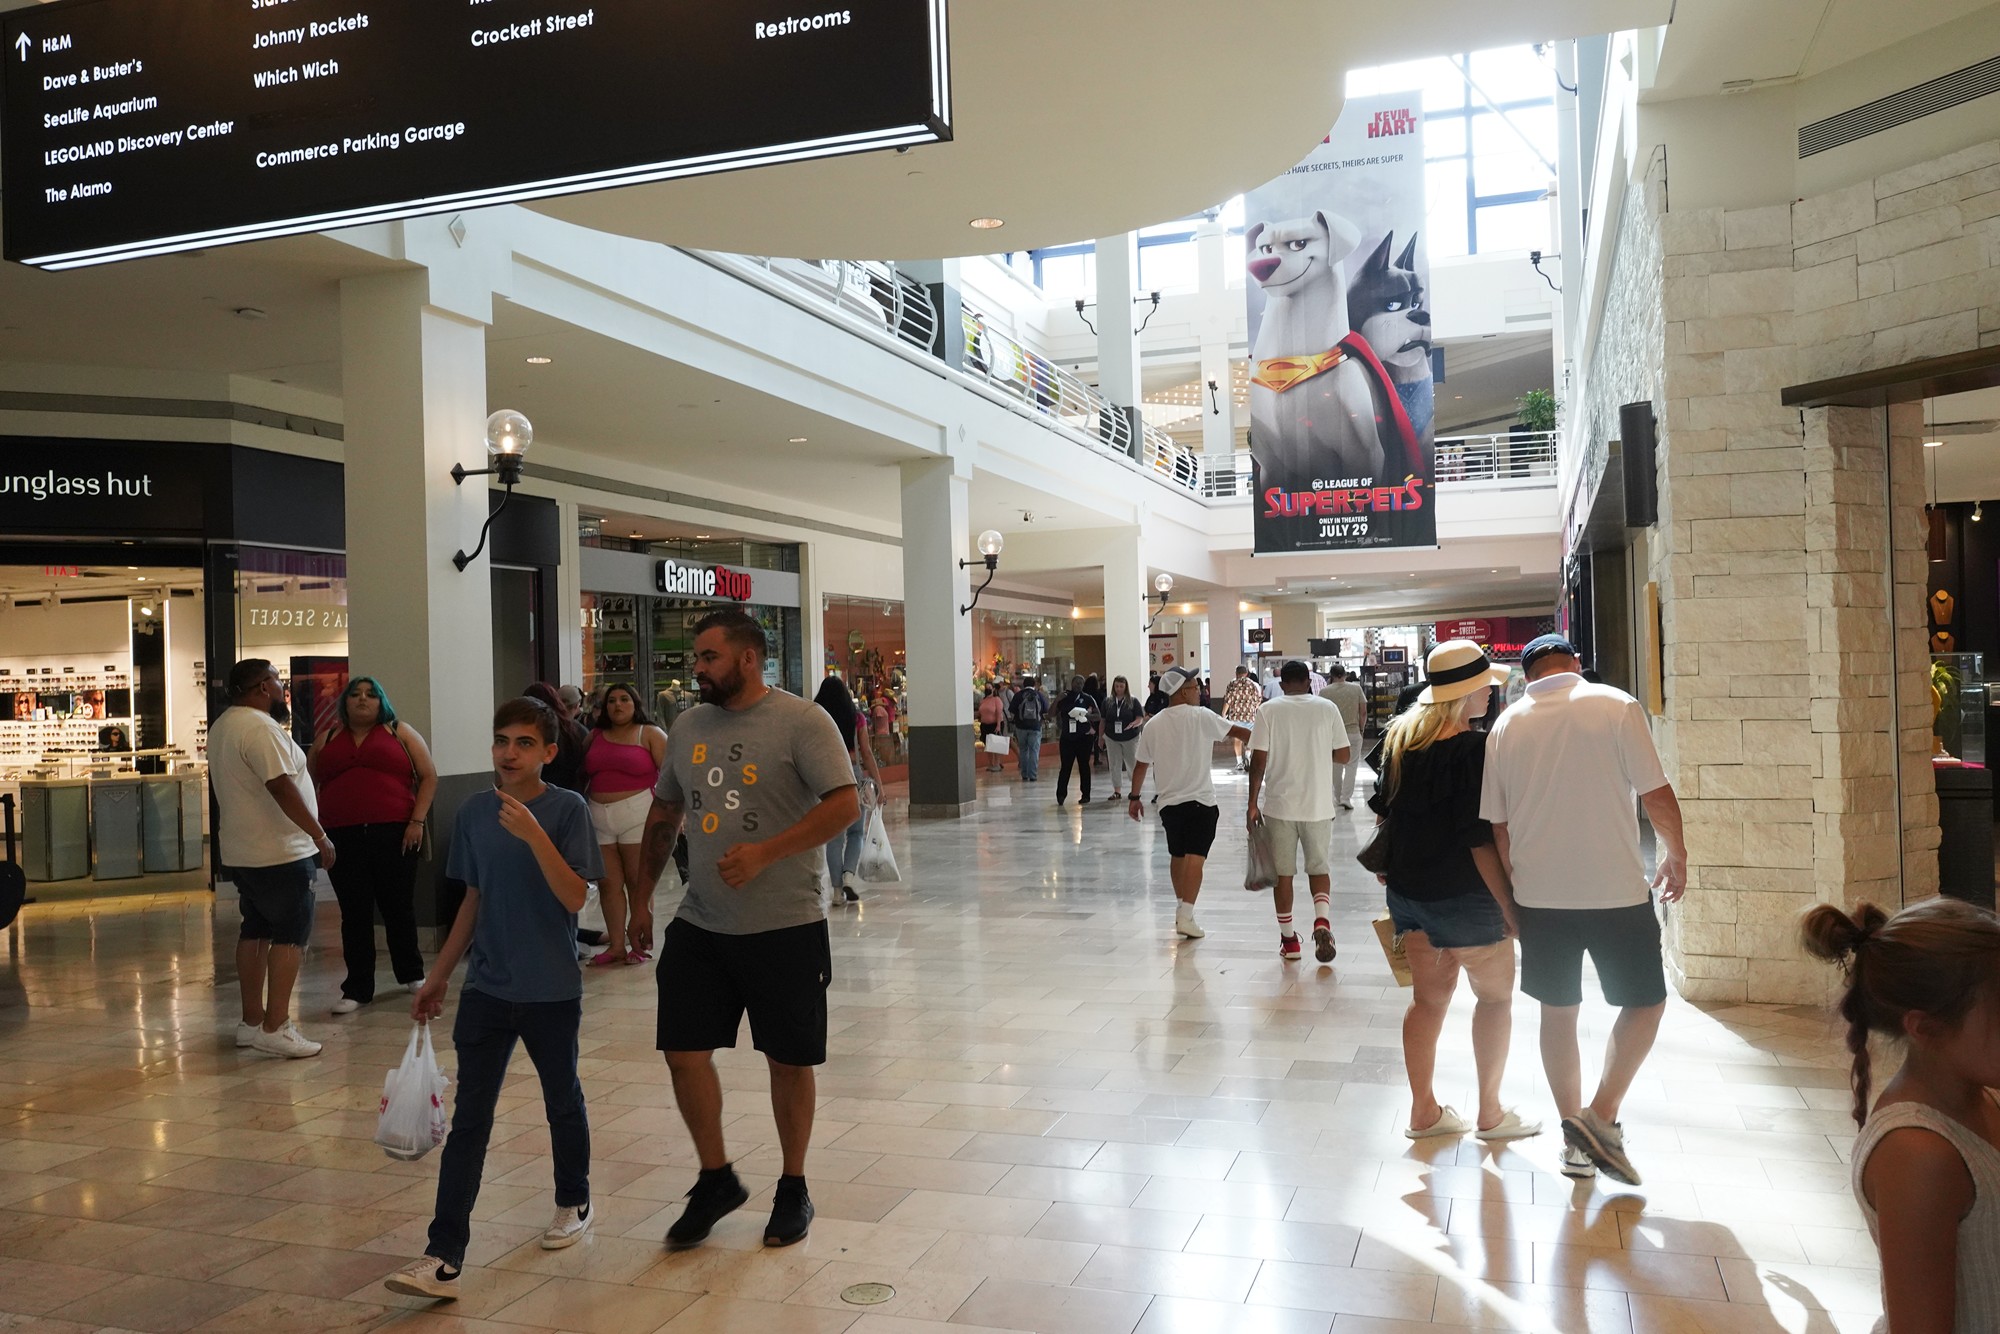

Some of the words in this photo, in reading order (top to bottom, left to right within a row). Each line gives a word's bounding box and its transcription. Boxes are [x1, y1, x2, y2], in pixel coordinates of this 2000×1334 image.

[252, 27, 306, 49] Johnny
[309, 12, 369, 38] Rockets
[470, 18, 542, 47] Crockett
[545, 8, 594, 34] Street
[755, 10, 852, 40] Restrooms
[42, 33, 72, 54] H&M
[43, 74, 78, 91] Dave
[80, 69, 90, 84] &
[93, 58, 143, 81] Buster's
[253, 66, 299, 89] Which
[301, 58, 339, 80] Wich
[43, 107, 90, 129] SeaLife
[92, 96, 158, 120] Aquarium
[1367, 117, 1417, 138] HART
[1374, 108, 1409, 122] KEVIN
[44, 140, 115, 166] LEGOLAND
[117, 130, 184, 153] Discovery
[186, 120, 234, 141] Center
[256, 143, 339, 168] Commerce
[343, 132, 400, 158] Parking
[404, 121, 466, 148] Garage
[1291, 165, 1310, 175] HAVE
[1311, 161, 1341, 173] SECRETS,
[1342, 158, 1366, 168] THEIRS
[1366, 157, 1380, 165] ARE
[1381, 153, 1404, 164] SUPER
[44, 187, 68, 204] The
[70, 181, 113, 200] Alamo
[107, 471, 153, 497] hut
[1324, 478, 1359, 489] LEAGUE
[1361, 477, 1373, 487] OF
[1319, 524, 1349, 538] JULY
[1352, 523, 1368, 536] 29
[664, 559, 752, 601] GameStop
